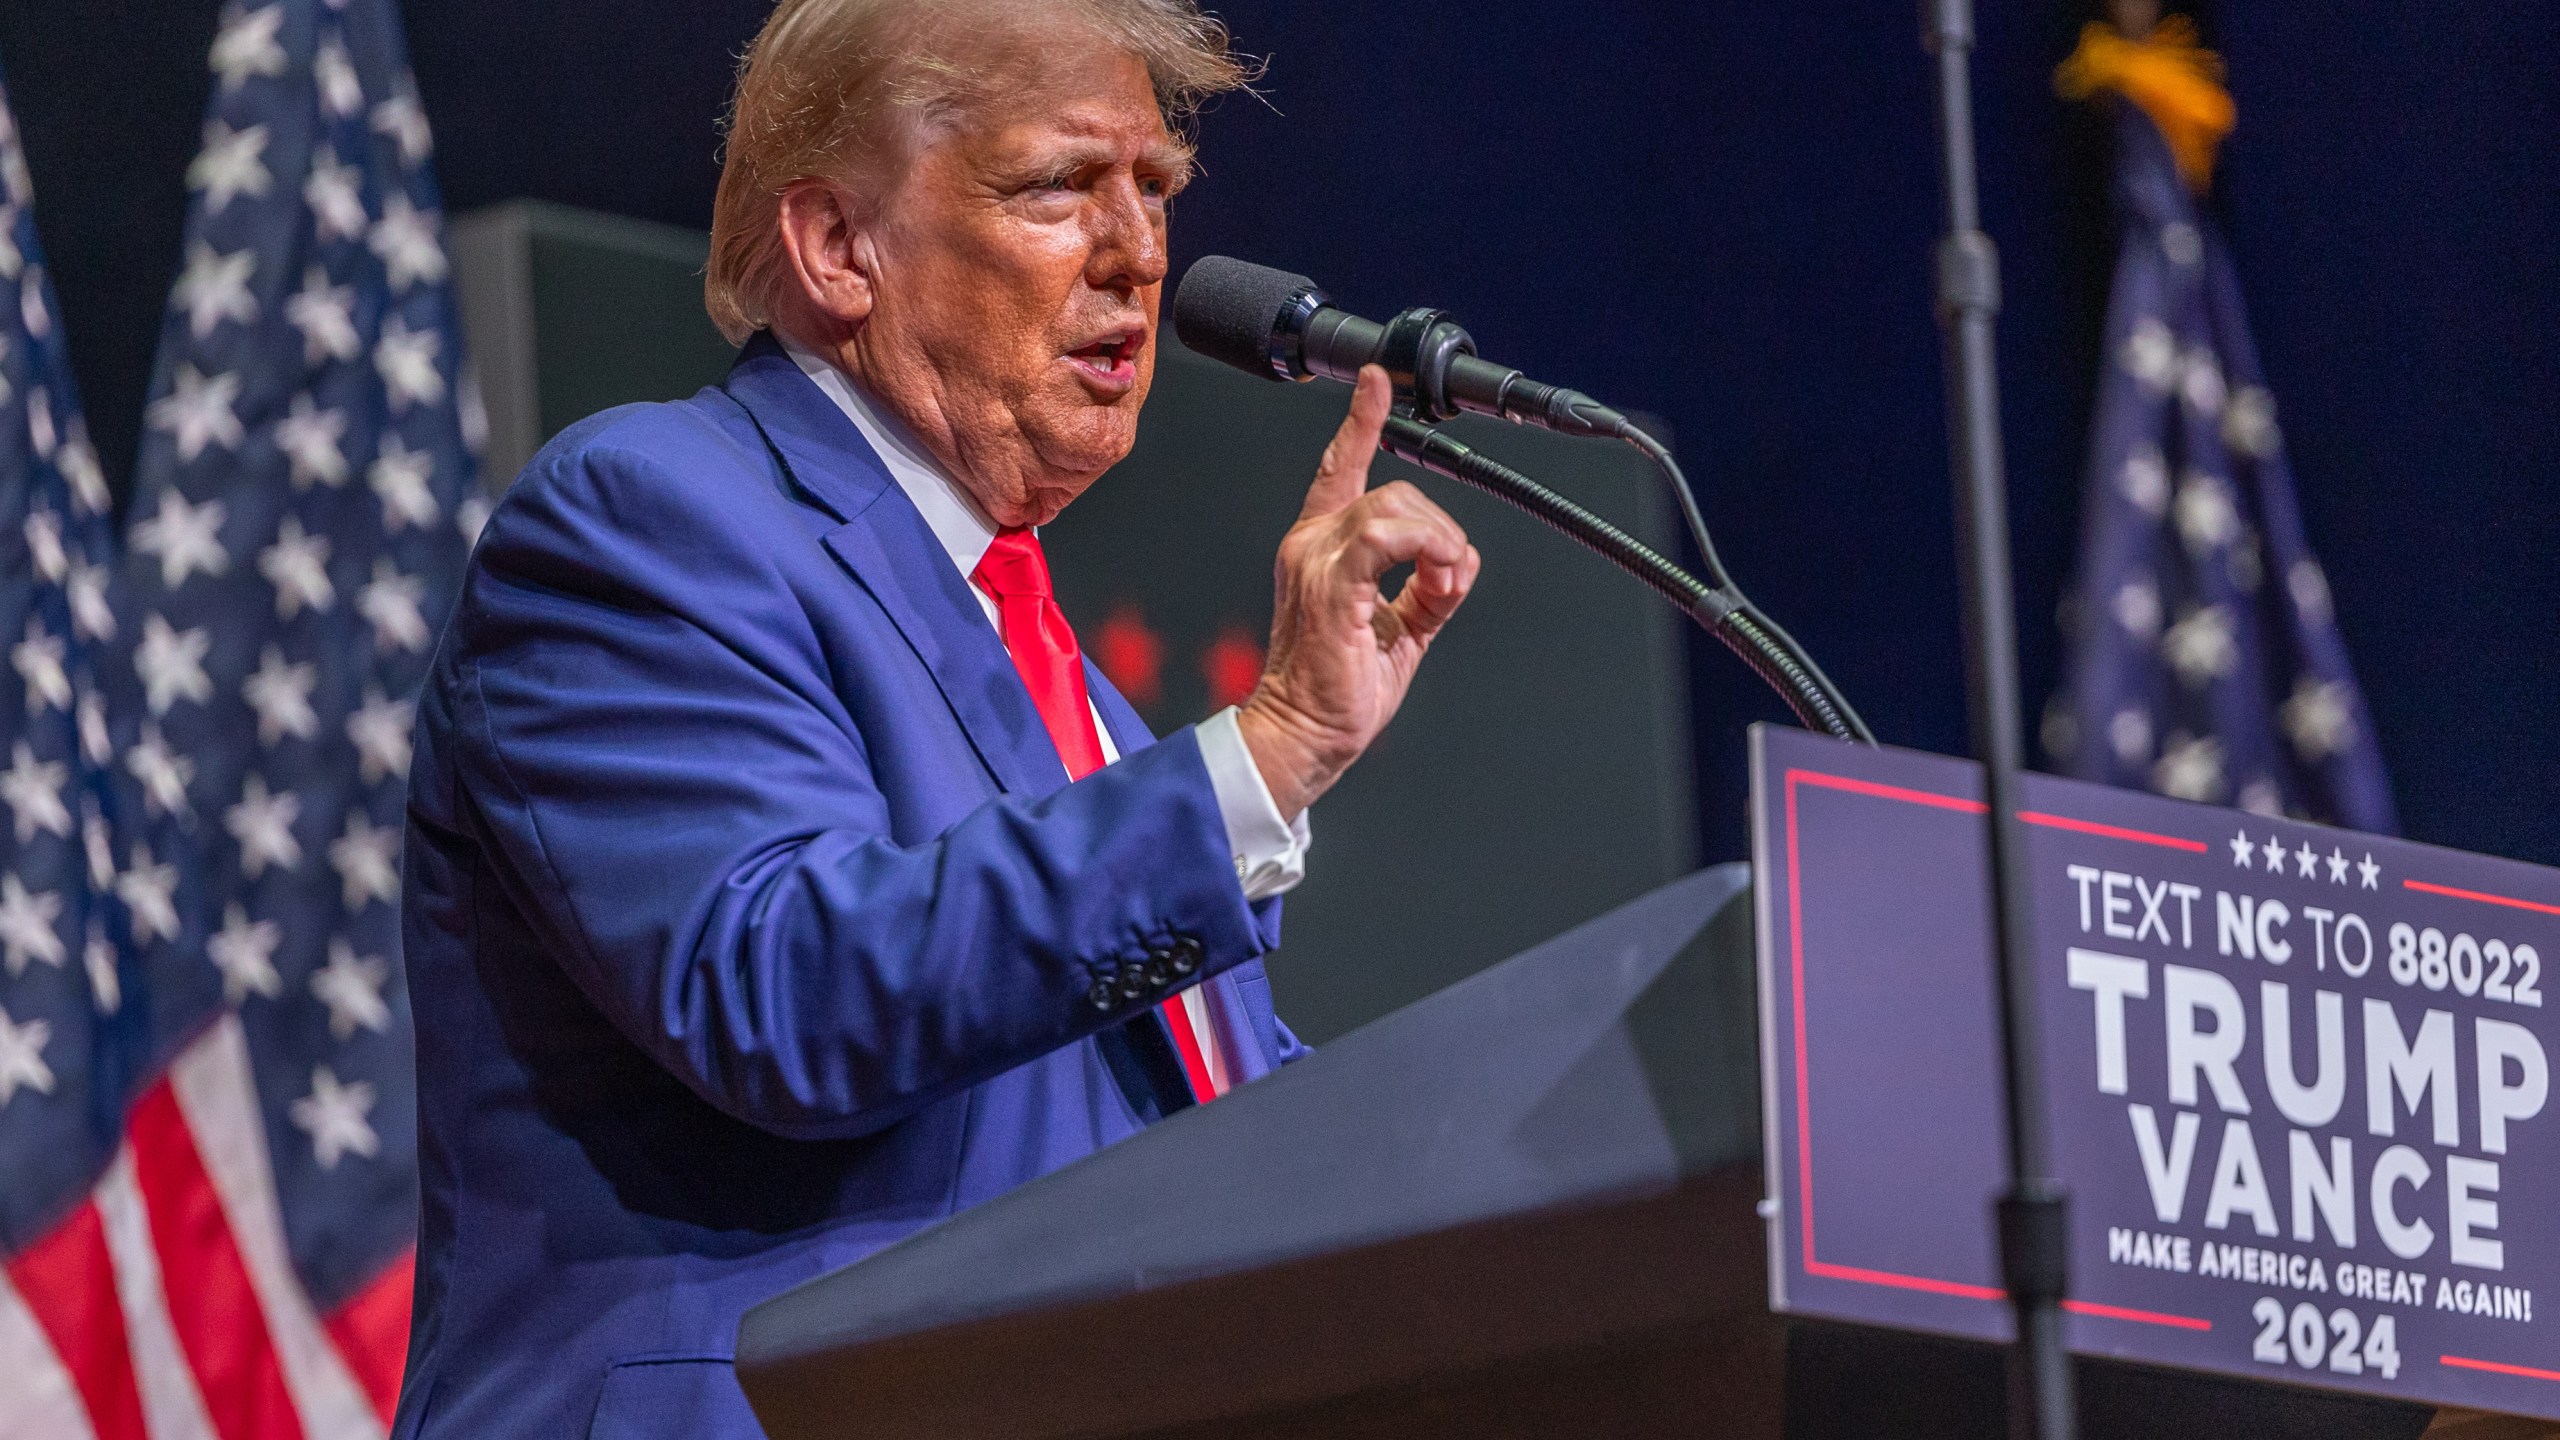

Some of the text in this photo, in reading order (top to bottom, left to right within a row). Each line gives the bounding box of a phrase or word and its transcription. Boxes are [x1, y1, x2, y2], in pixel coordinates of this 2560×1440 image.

[2067, 864, 2543, 1008] TEXT NC TO 88022
[2067, 946, 2550, 1155] TRUMP
[2128, 1103, 2504, 1270] VANCE
[2107, 1227, 2532, 1322] MAKE AMERICA GREAT AGAIN!
[2252, 1297, 2400, 1380] 2024
